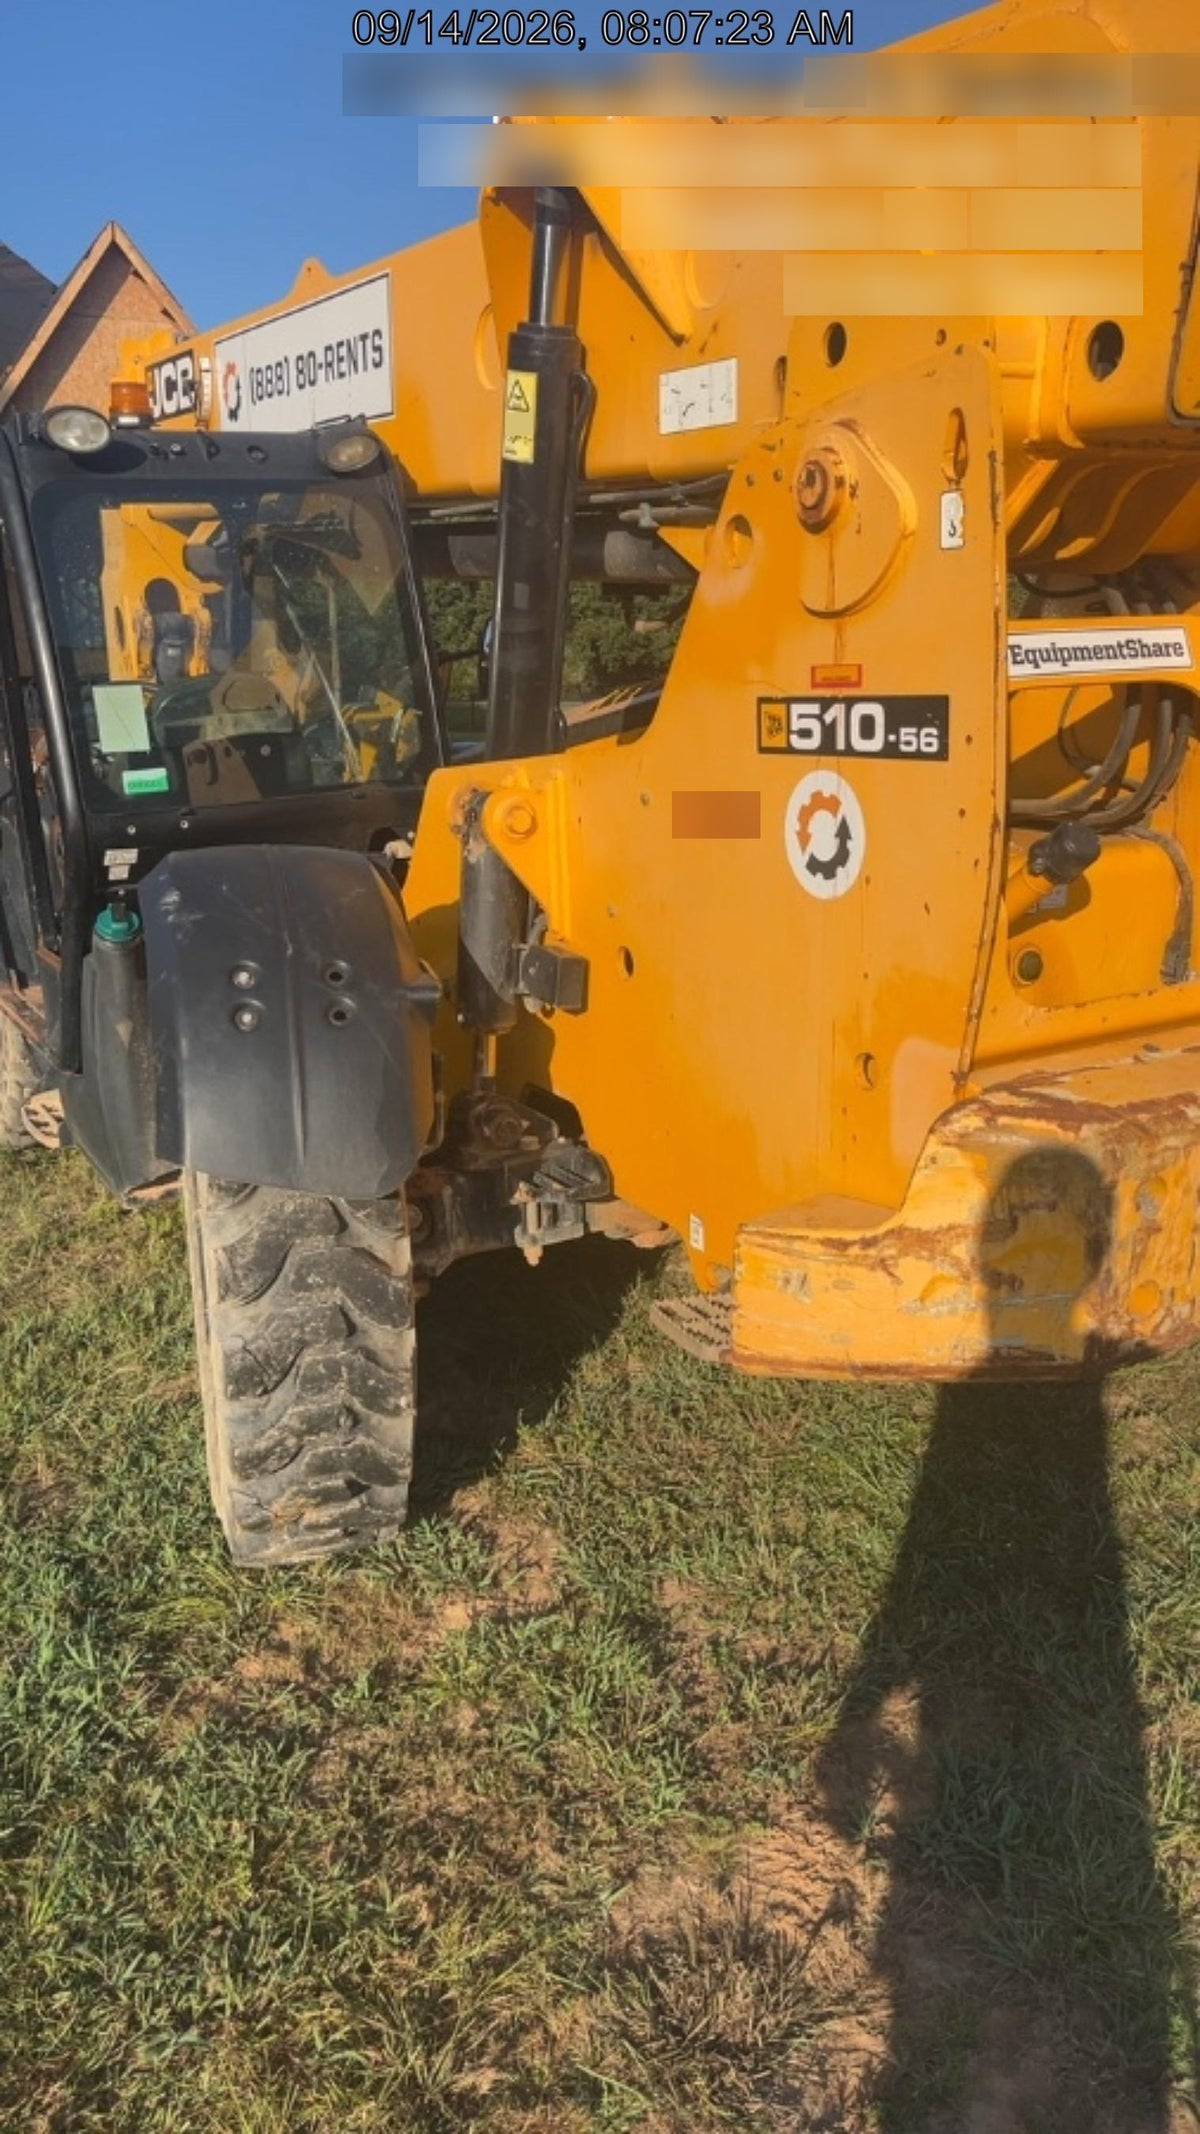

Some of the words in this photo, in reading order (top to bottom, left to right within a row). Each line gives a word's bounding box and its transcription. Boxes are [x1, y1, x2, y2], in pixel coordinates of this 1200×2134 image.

[249, 355, 291, 406] (888)
[296, 328, 384, 391] 80-RENTS
[1009, 638, 1185, 669] EquipmentShare
